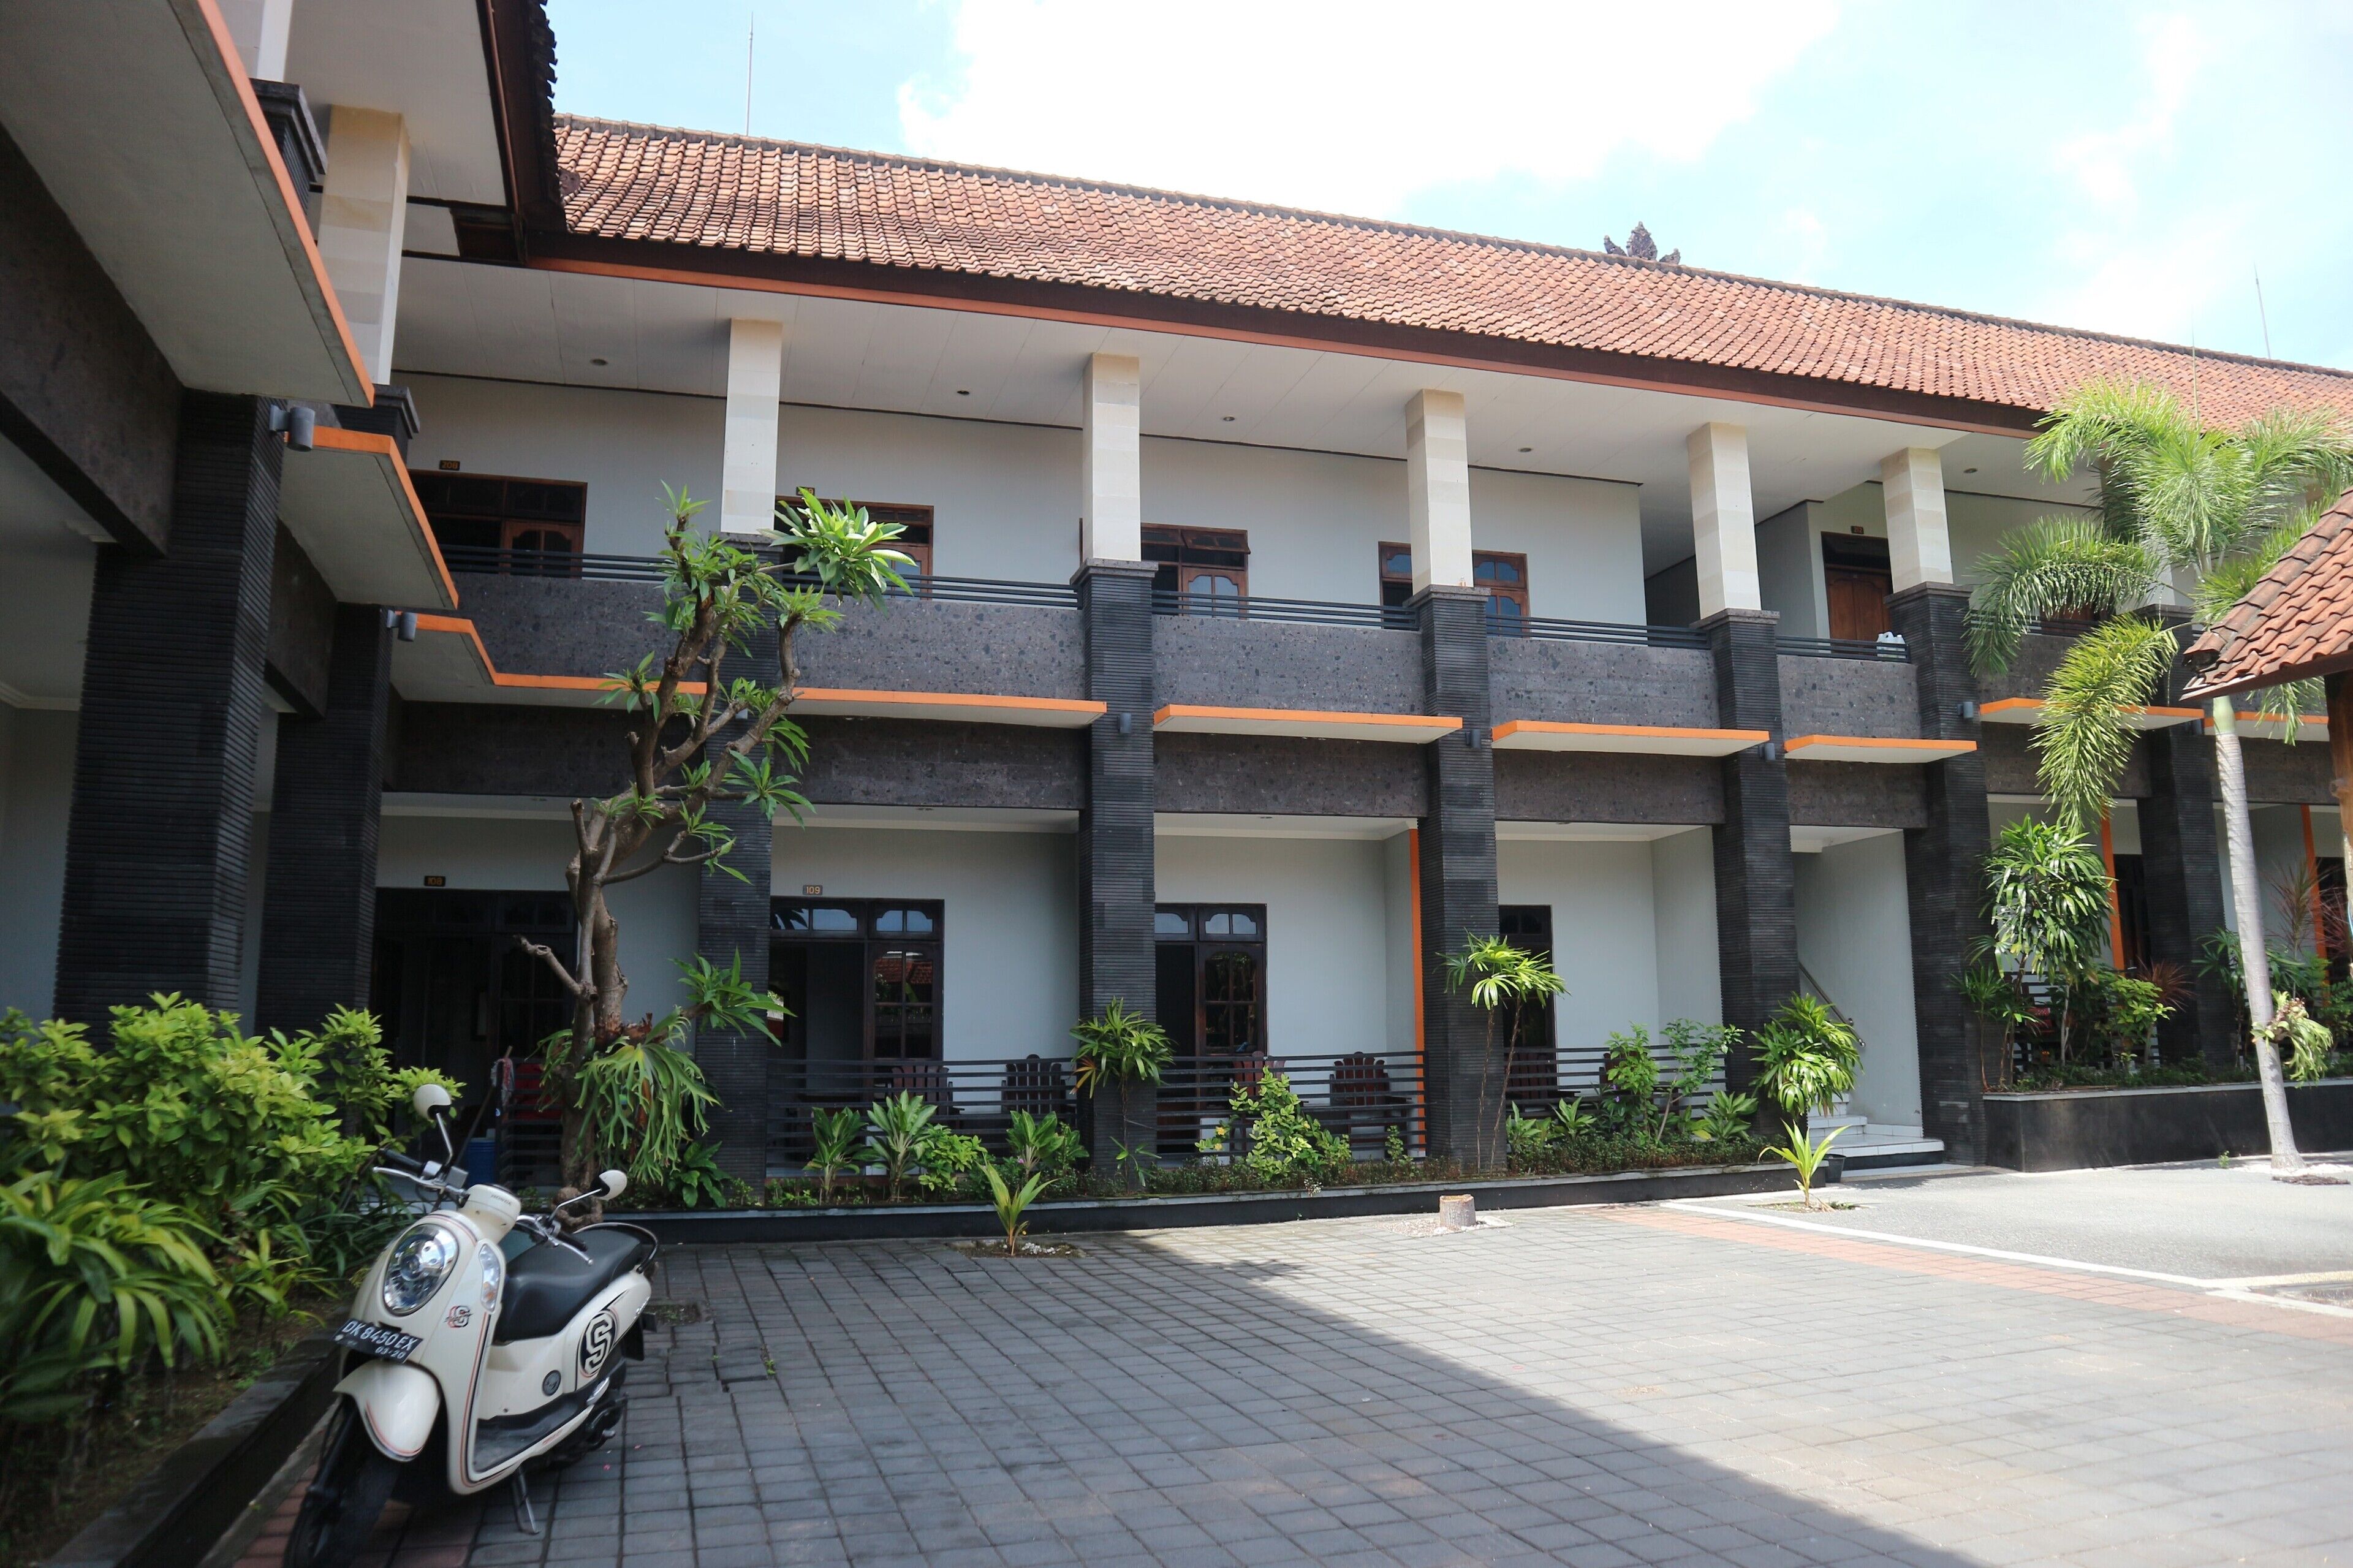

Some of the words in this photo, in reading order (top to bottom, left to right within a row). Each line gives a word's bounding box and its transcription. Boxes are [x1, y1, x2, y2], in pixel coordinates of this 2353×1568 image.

[342, 1320, 366, 1336] DK
[360, 1327, 400, 1346] 8450
[394, 1336, 417, 1350] EX
